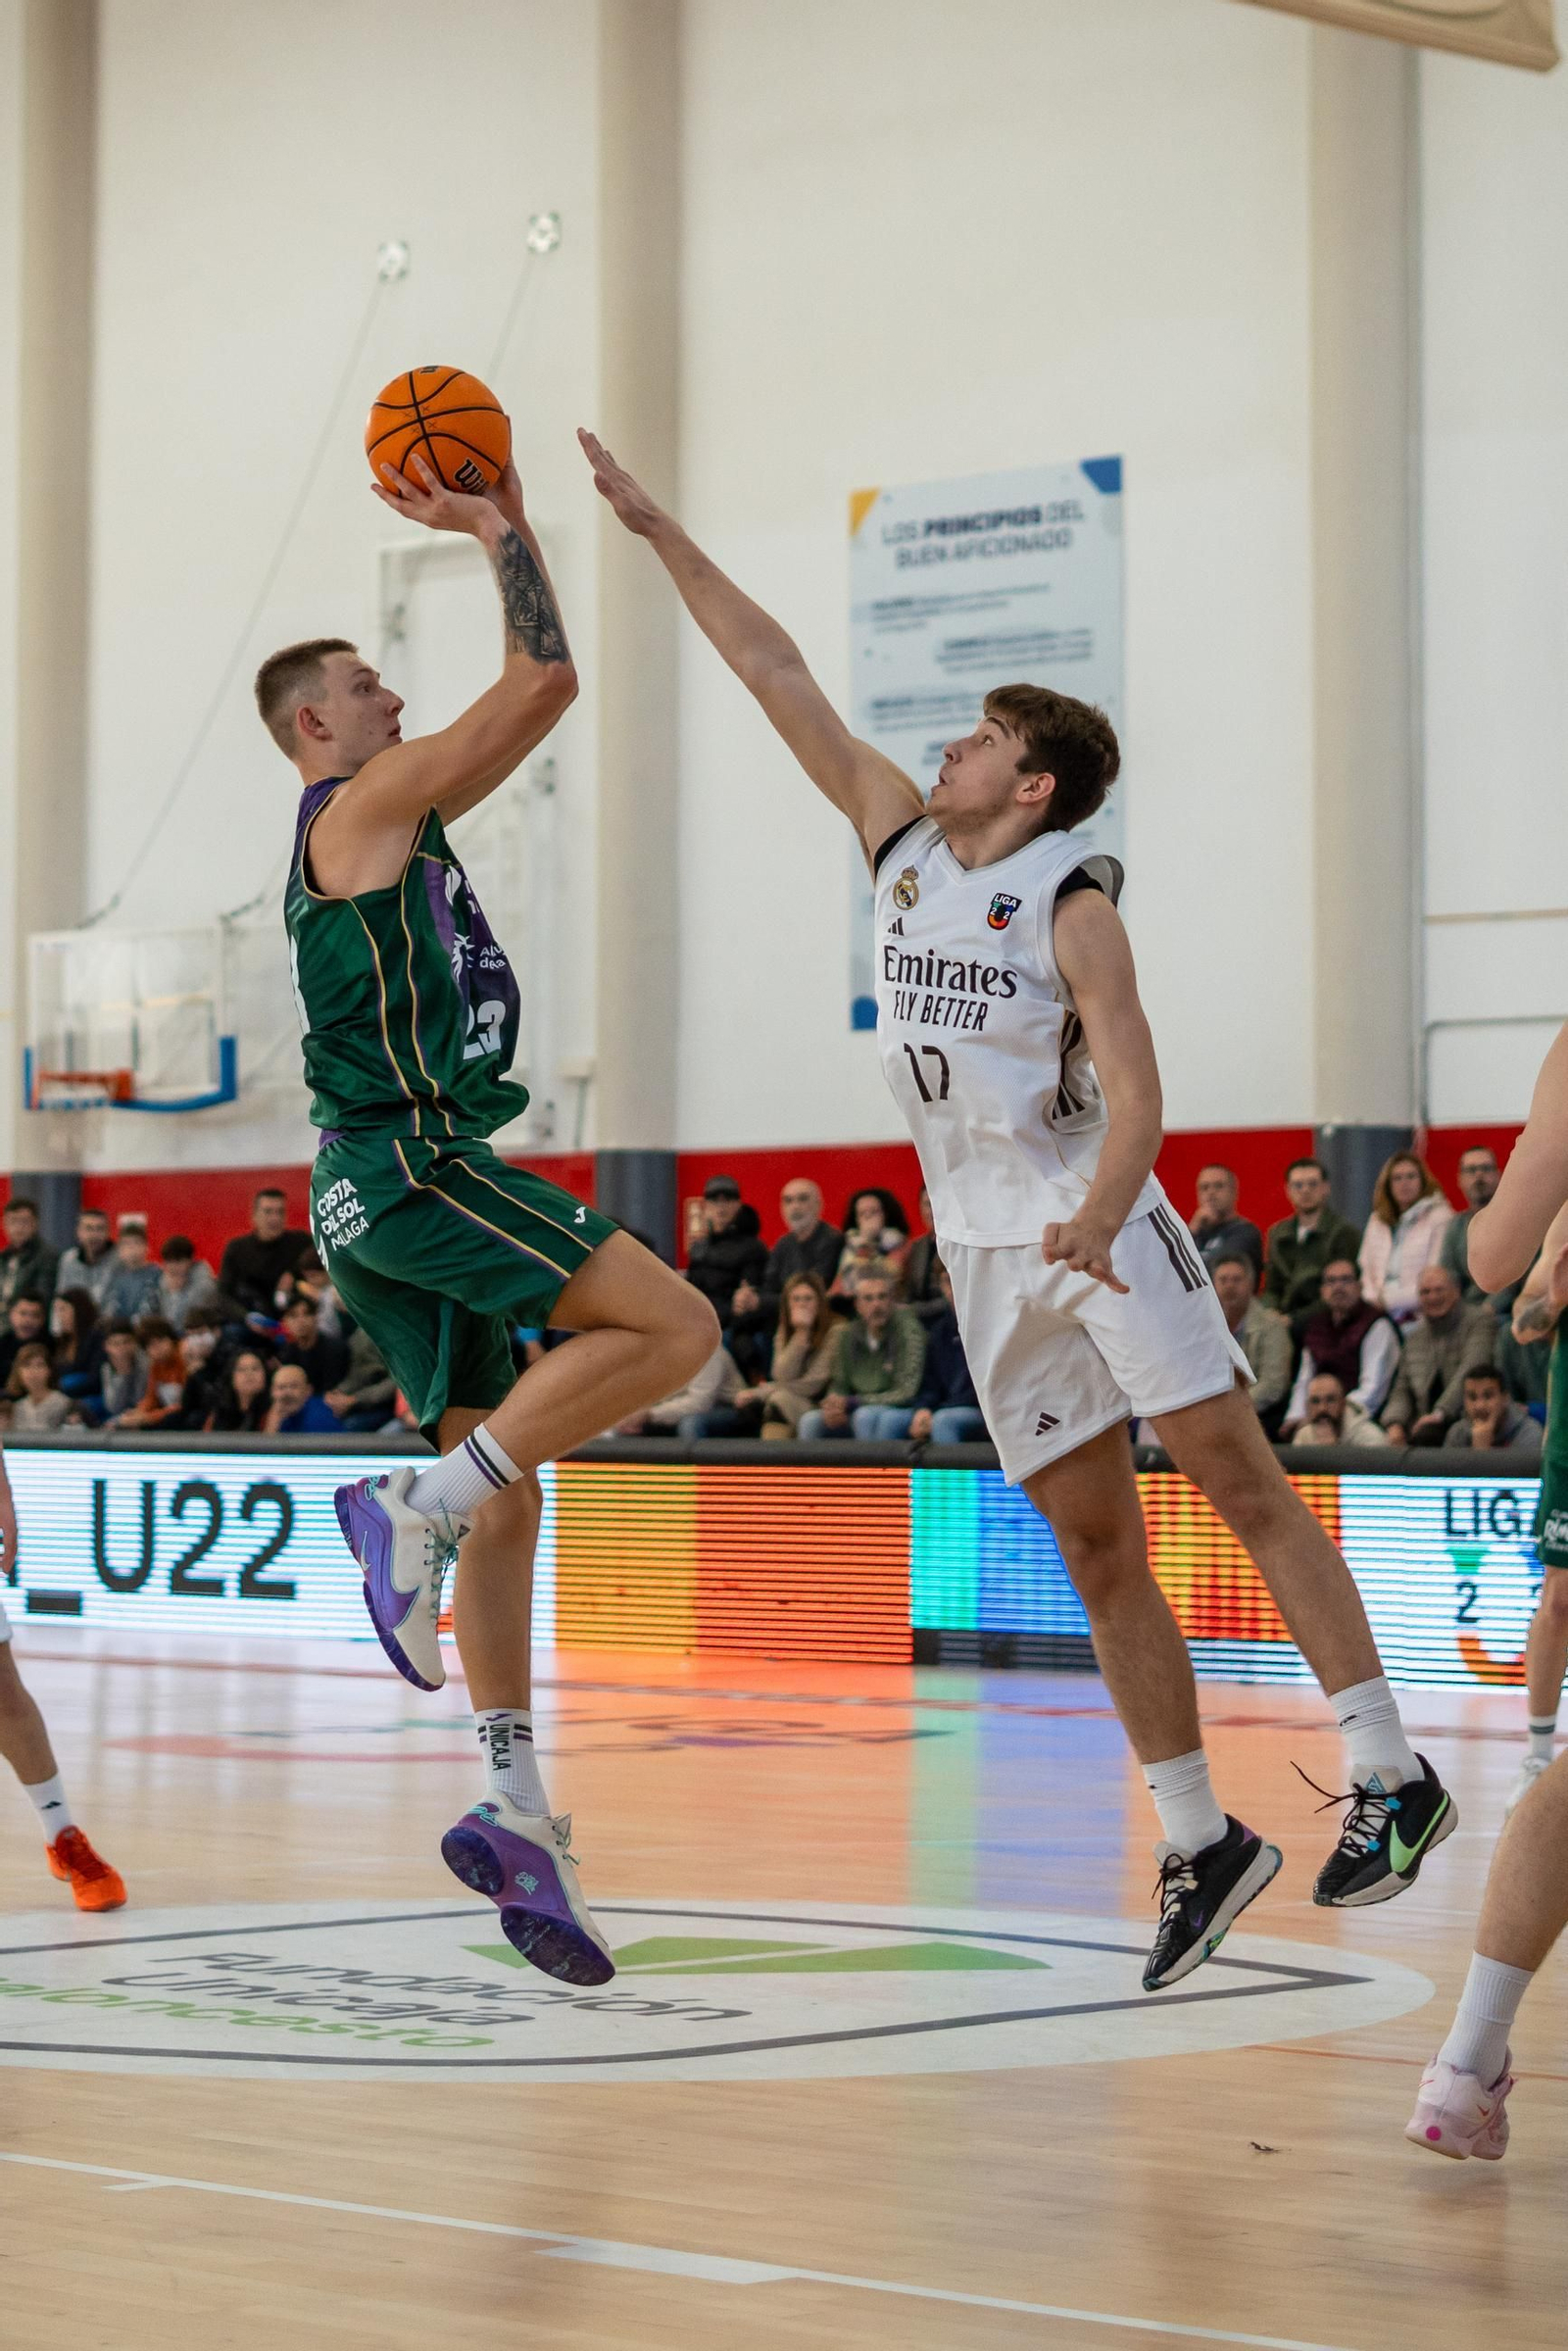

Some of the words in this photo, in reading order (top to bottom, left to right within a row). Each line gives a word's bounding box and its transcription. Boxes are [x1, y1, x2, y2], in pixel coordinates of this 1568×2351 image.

[924, 506, 1042, 537] PRINCIPIOS
[953, 527, 1071, 561] AFICIONADO
[994, 894, 1017, 907] LIGA
[883, 945, 1017, 999] Emirates
[893, 990, 917, 1021] FLY
[920, 994, 989, 1031] BETTER
[904, 1043, 951, 1102] 17
[337, 1198, 366, 1224] SOL
[1446, 1490, 1535, 1536] LIG
[489, 1723, 512, 1771] UNICAJA
[101, 1972, 535, 2026] Unicaja
[147, 1952, 753, 2022] Fundación
